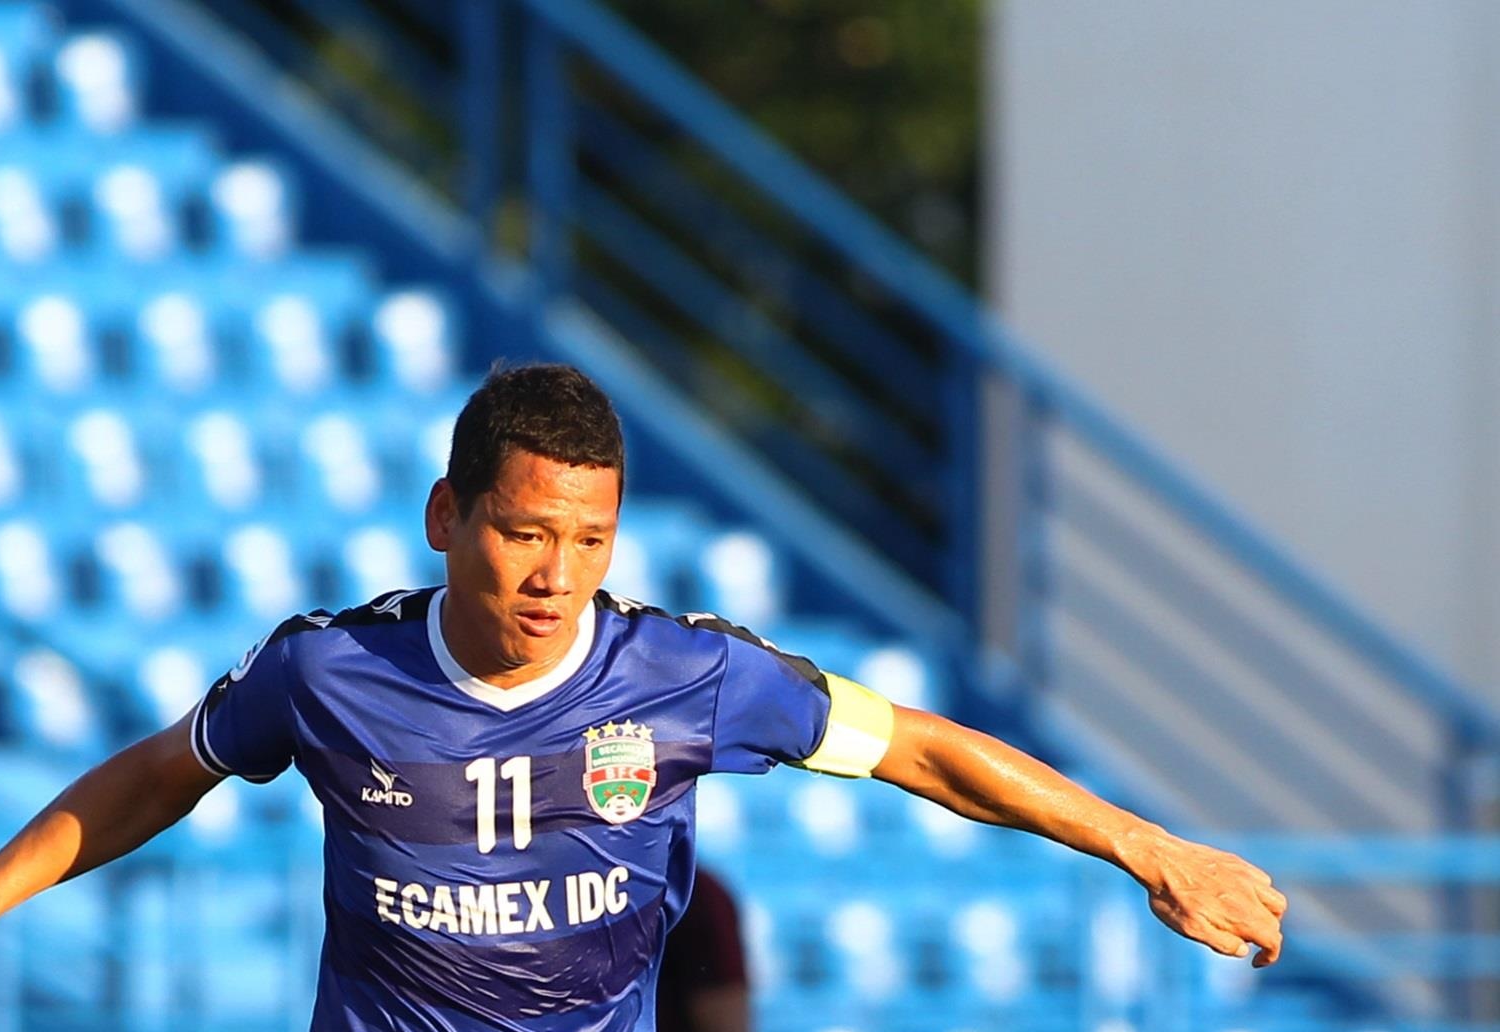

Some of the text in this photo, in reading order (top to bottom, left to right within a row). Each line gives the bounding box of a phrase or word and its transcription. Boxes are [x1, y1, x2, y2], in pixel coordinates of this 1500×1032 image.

[361, 787, 413, 807] KAMITO
[465, 756, 532, 854] 11
[566, 867, 629, 926] IDC
